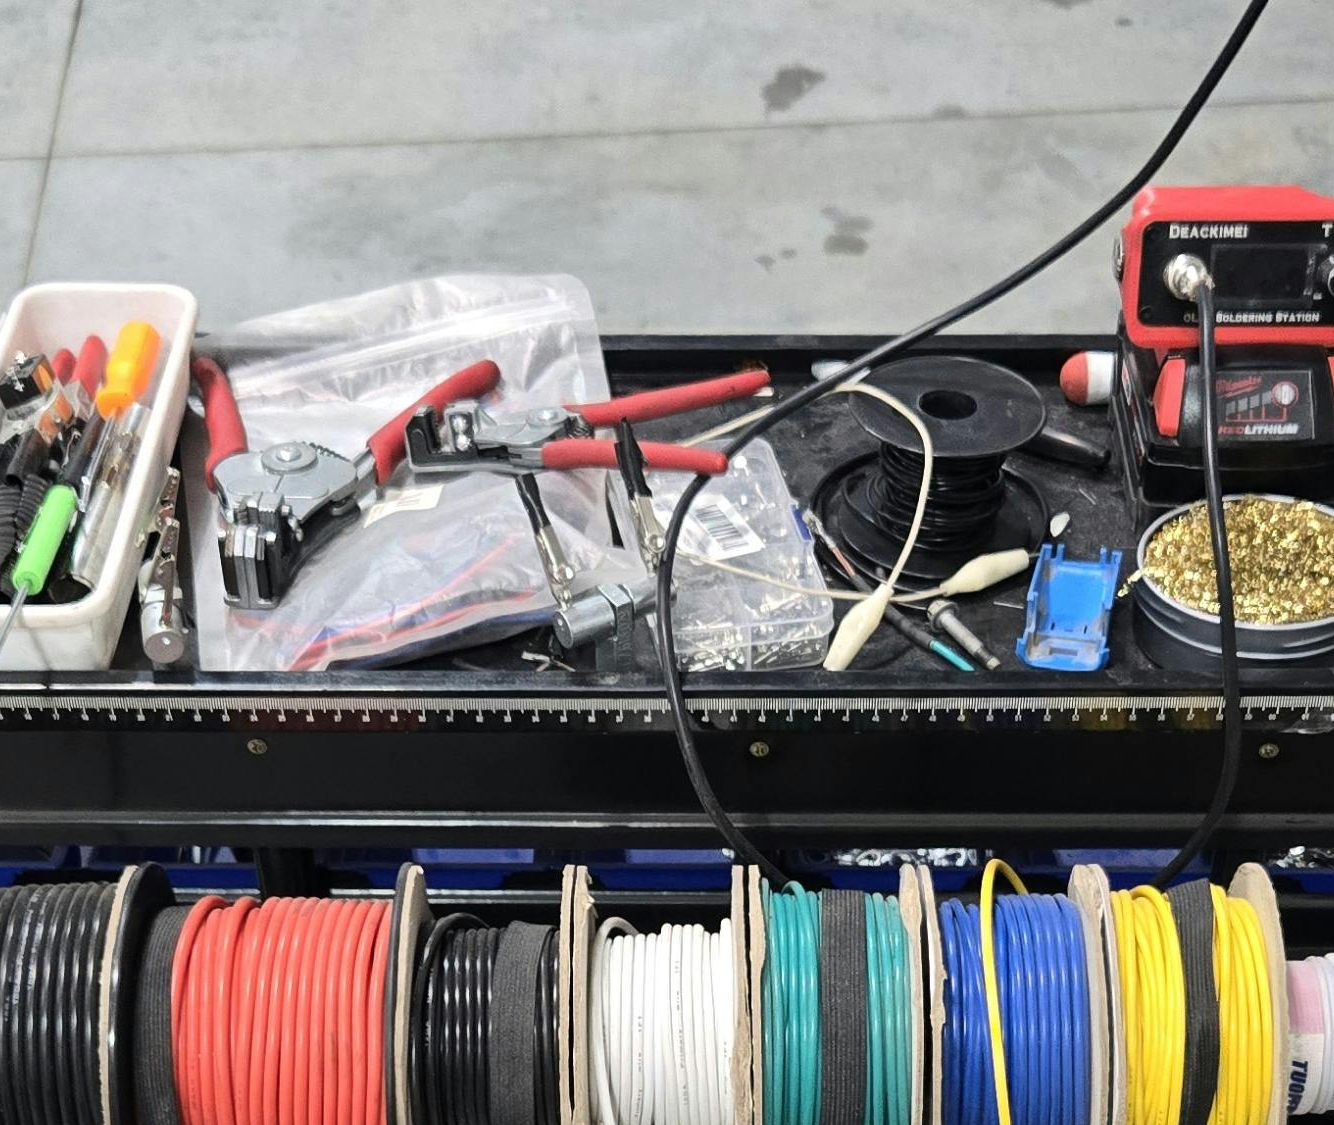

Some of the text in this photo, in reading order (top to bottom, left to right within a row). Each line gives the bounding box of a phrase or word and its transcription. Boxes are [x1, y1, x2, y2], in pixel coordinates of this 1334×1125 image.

[1168, 223, 1248, 239] DEACKIMEI
[1215, 310, 1273, 323] SOLDERING
[1275, 310, 1321, 323] STATION
